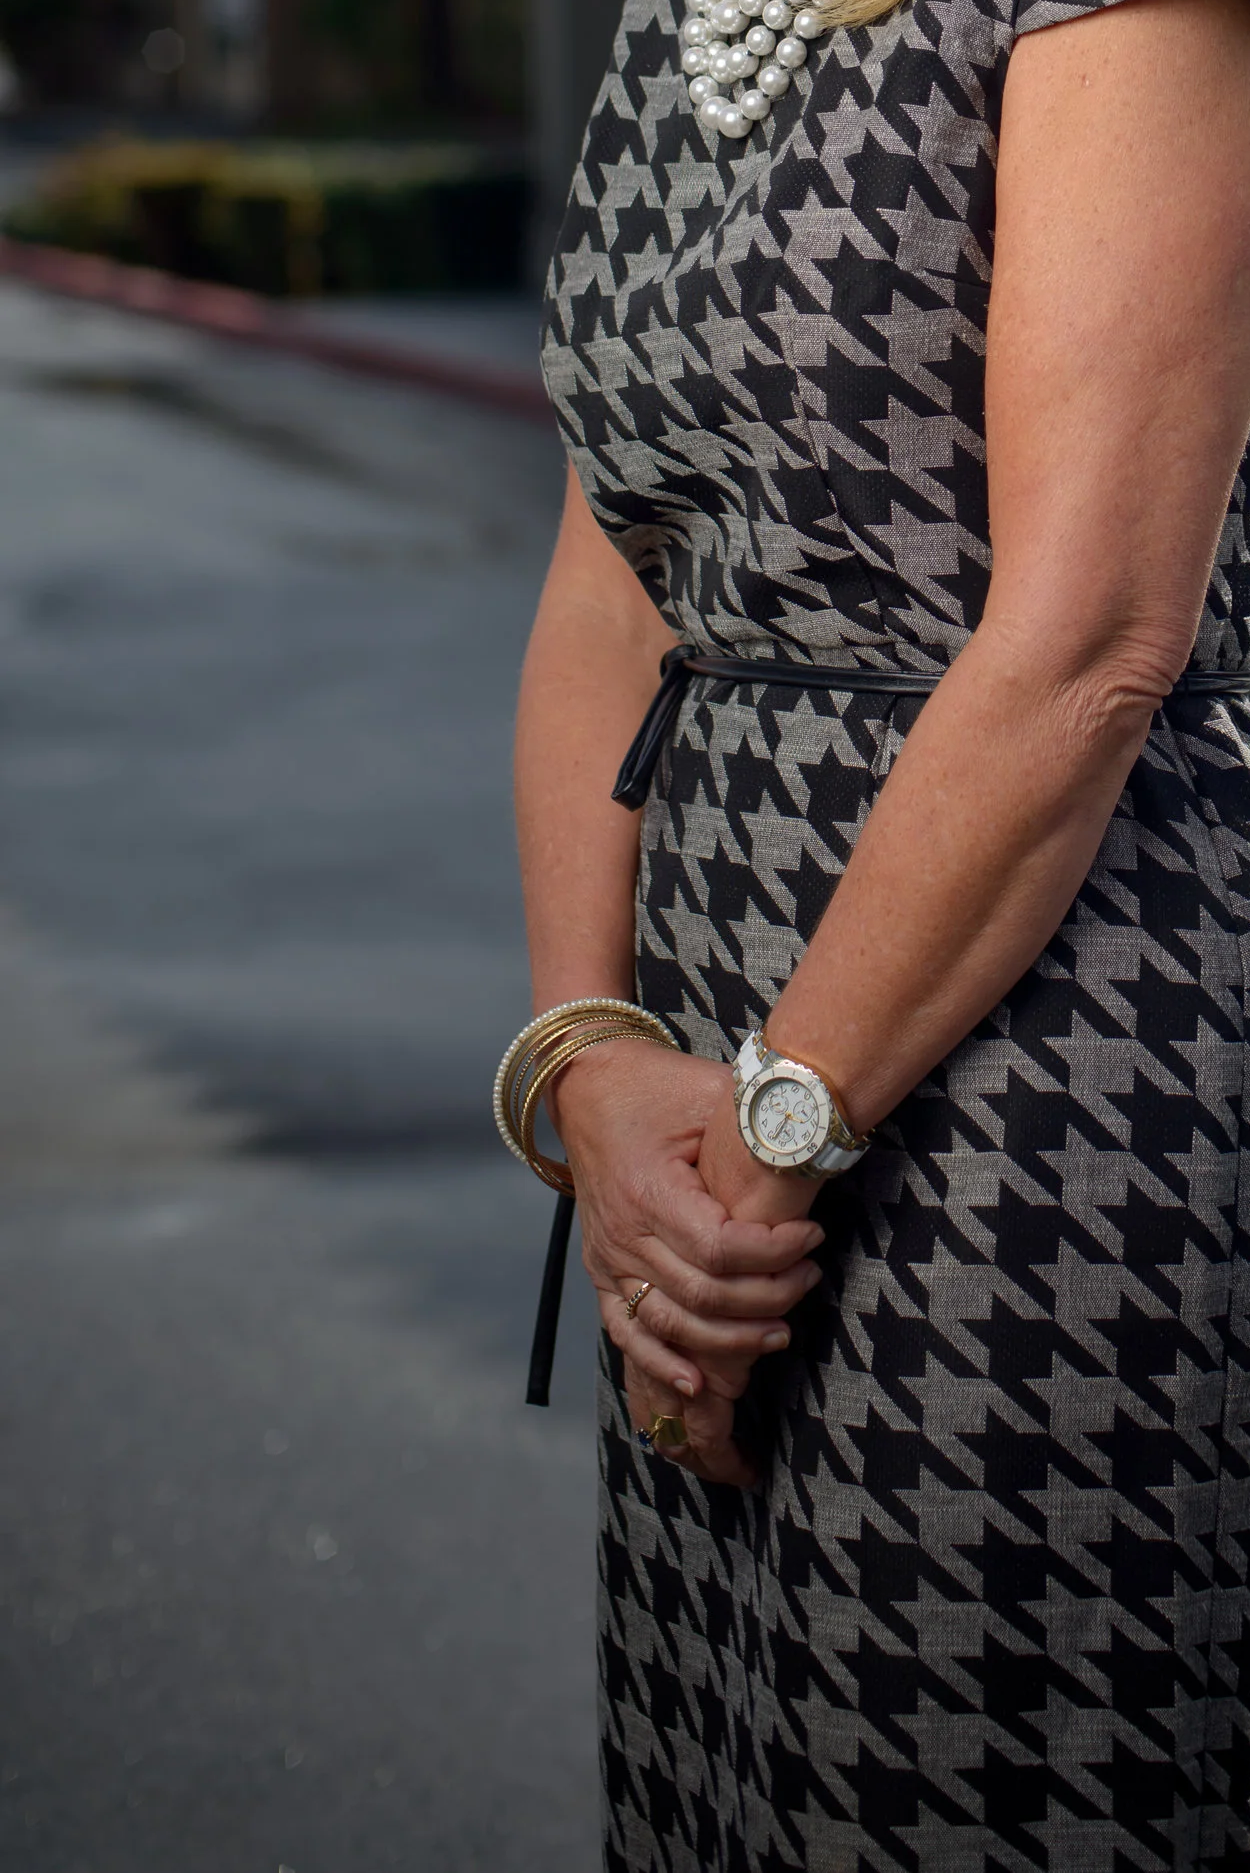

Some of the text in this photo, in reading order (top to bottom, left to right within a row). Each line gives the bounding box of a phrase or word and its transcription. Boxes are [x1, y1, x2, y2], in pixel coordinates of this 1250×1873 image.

[751, 1078, 761, 1090] 30
[762, 1118, 768, 1128] 4
[752, 1142, 761, 1153] 15
